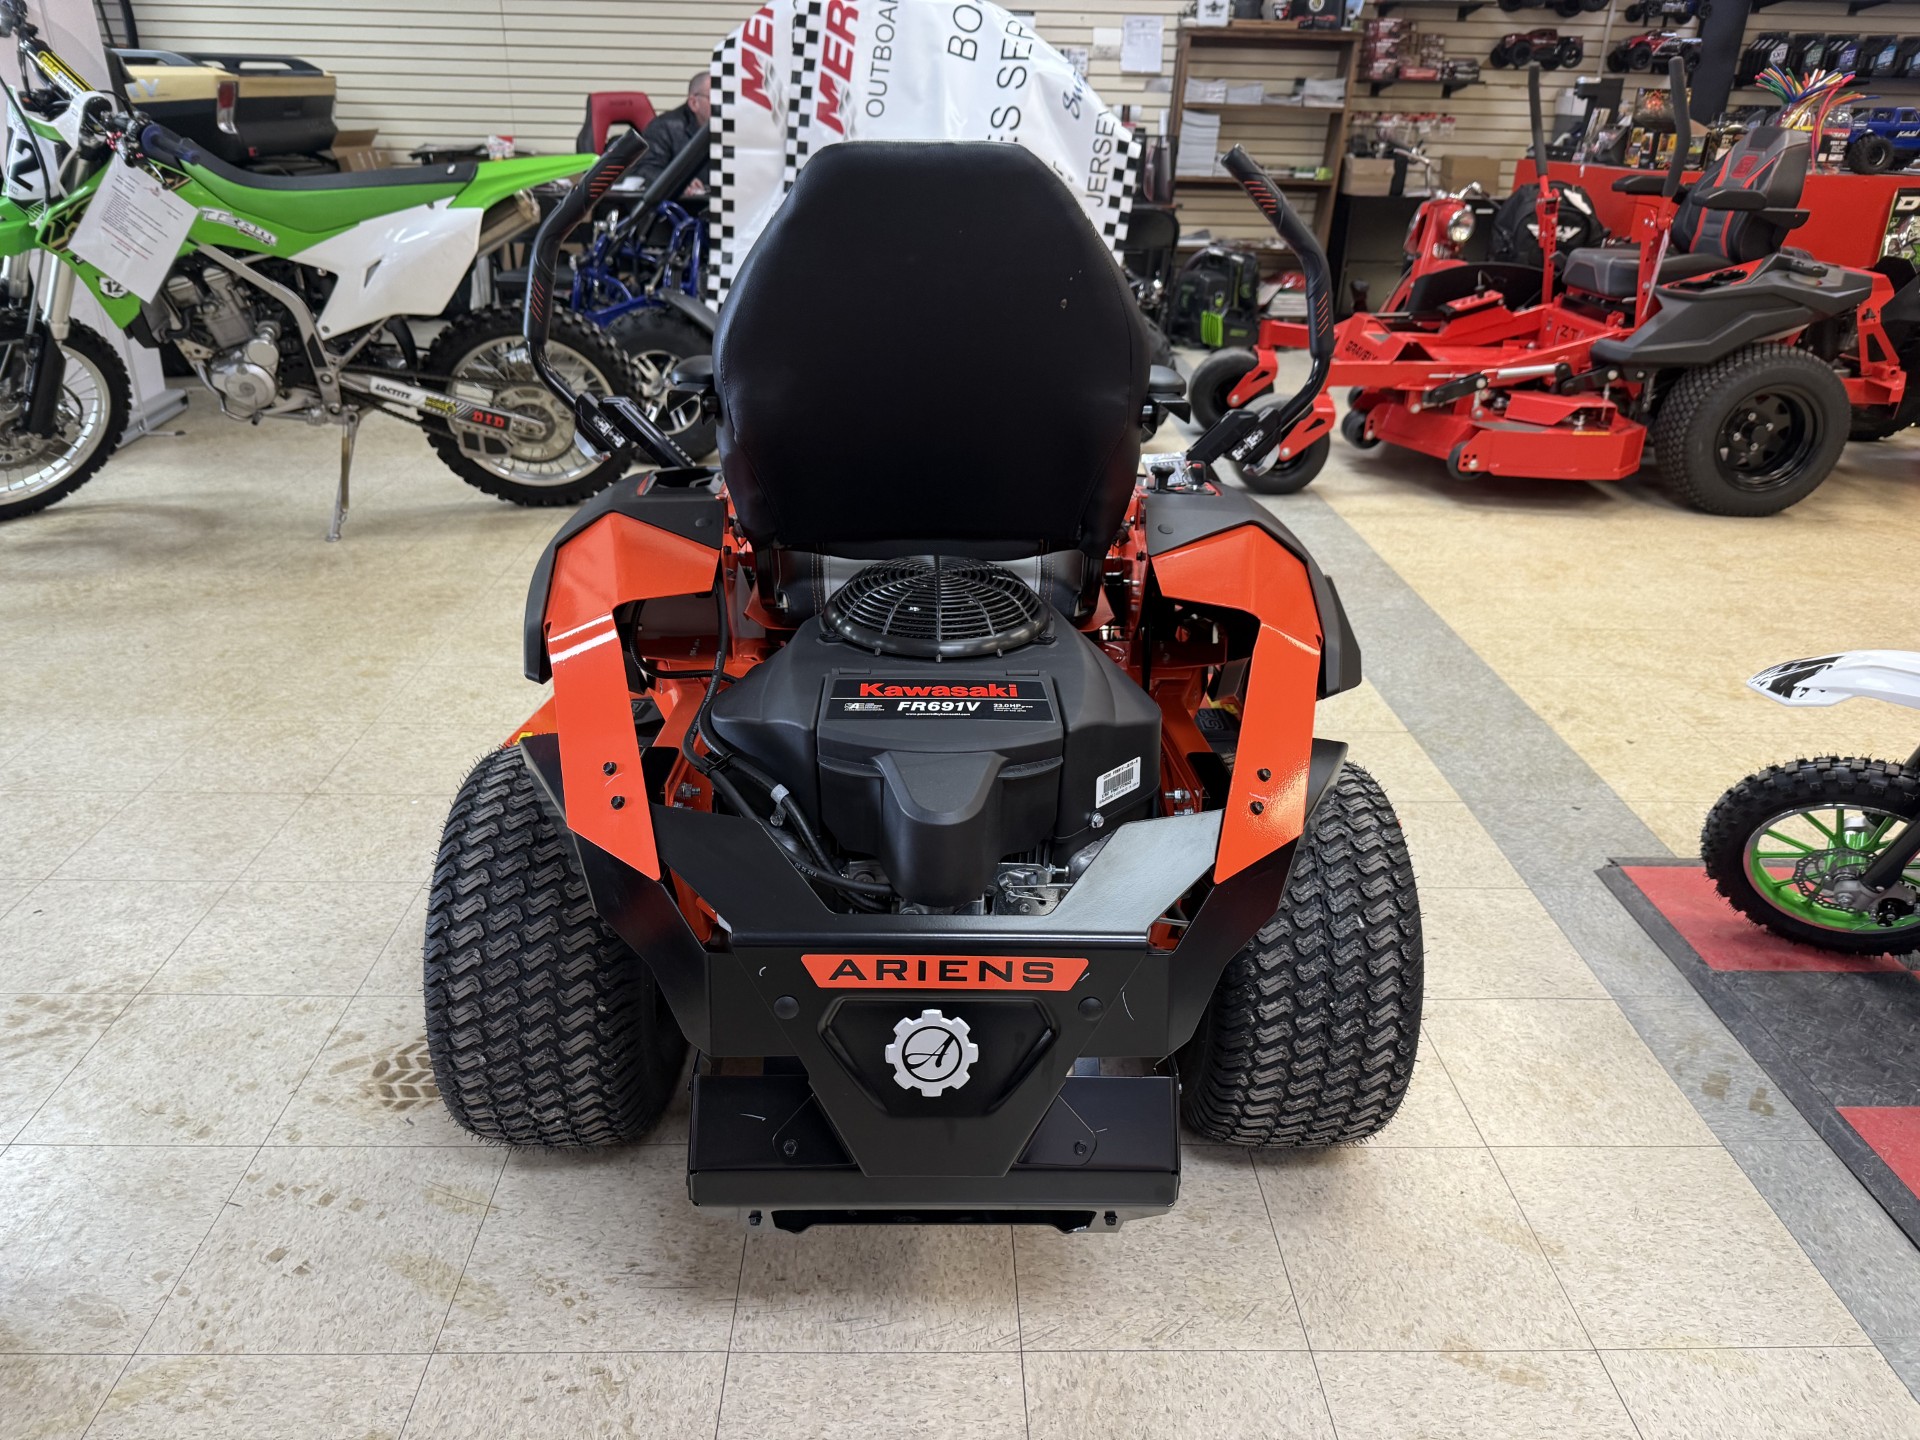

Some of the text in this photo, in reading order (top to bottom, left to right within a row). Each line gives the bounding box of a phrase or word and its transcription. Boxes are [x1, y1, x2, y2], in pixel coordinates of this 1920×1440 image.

[947, 0, 983, 61] BO
[816, 0, 859, 135] MER
[375, 383, 412, 400] LOCTITE
[859, 683, 1018, 698] Kawasaki
[897, 701, 981, 712] FR691V
[828, 958, 1054, 983] ARIENS
